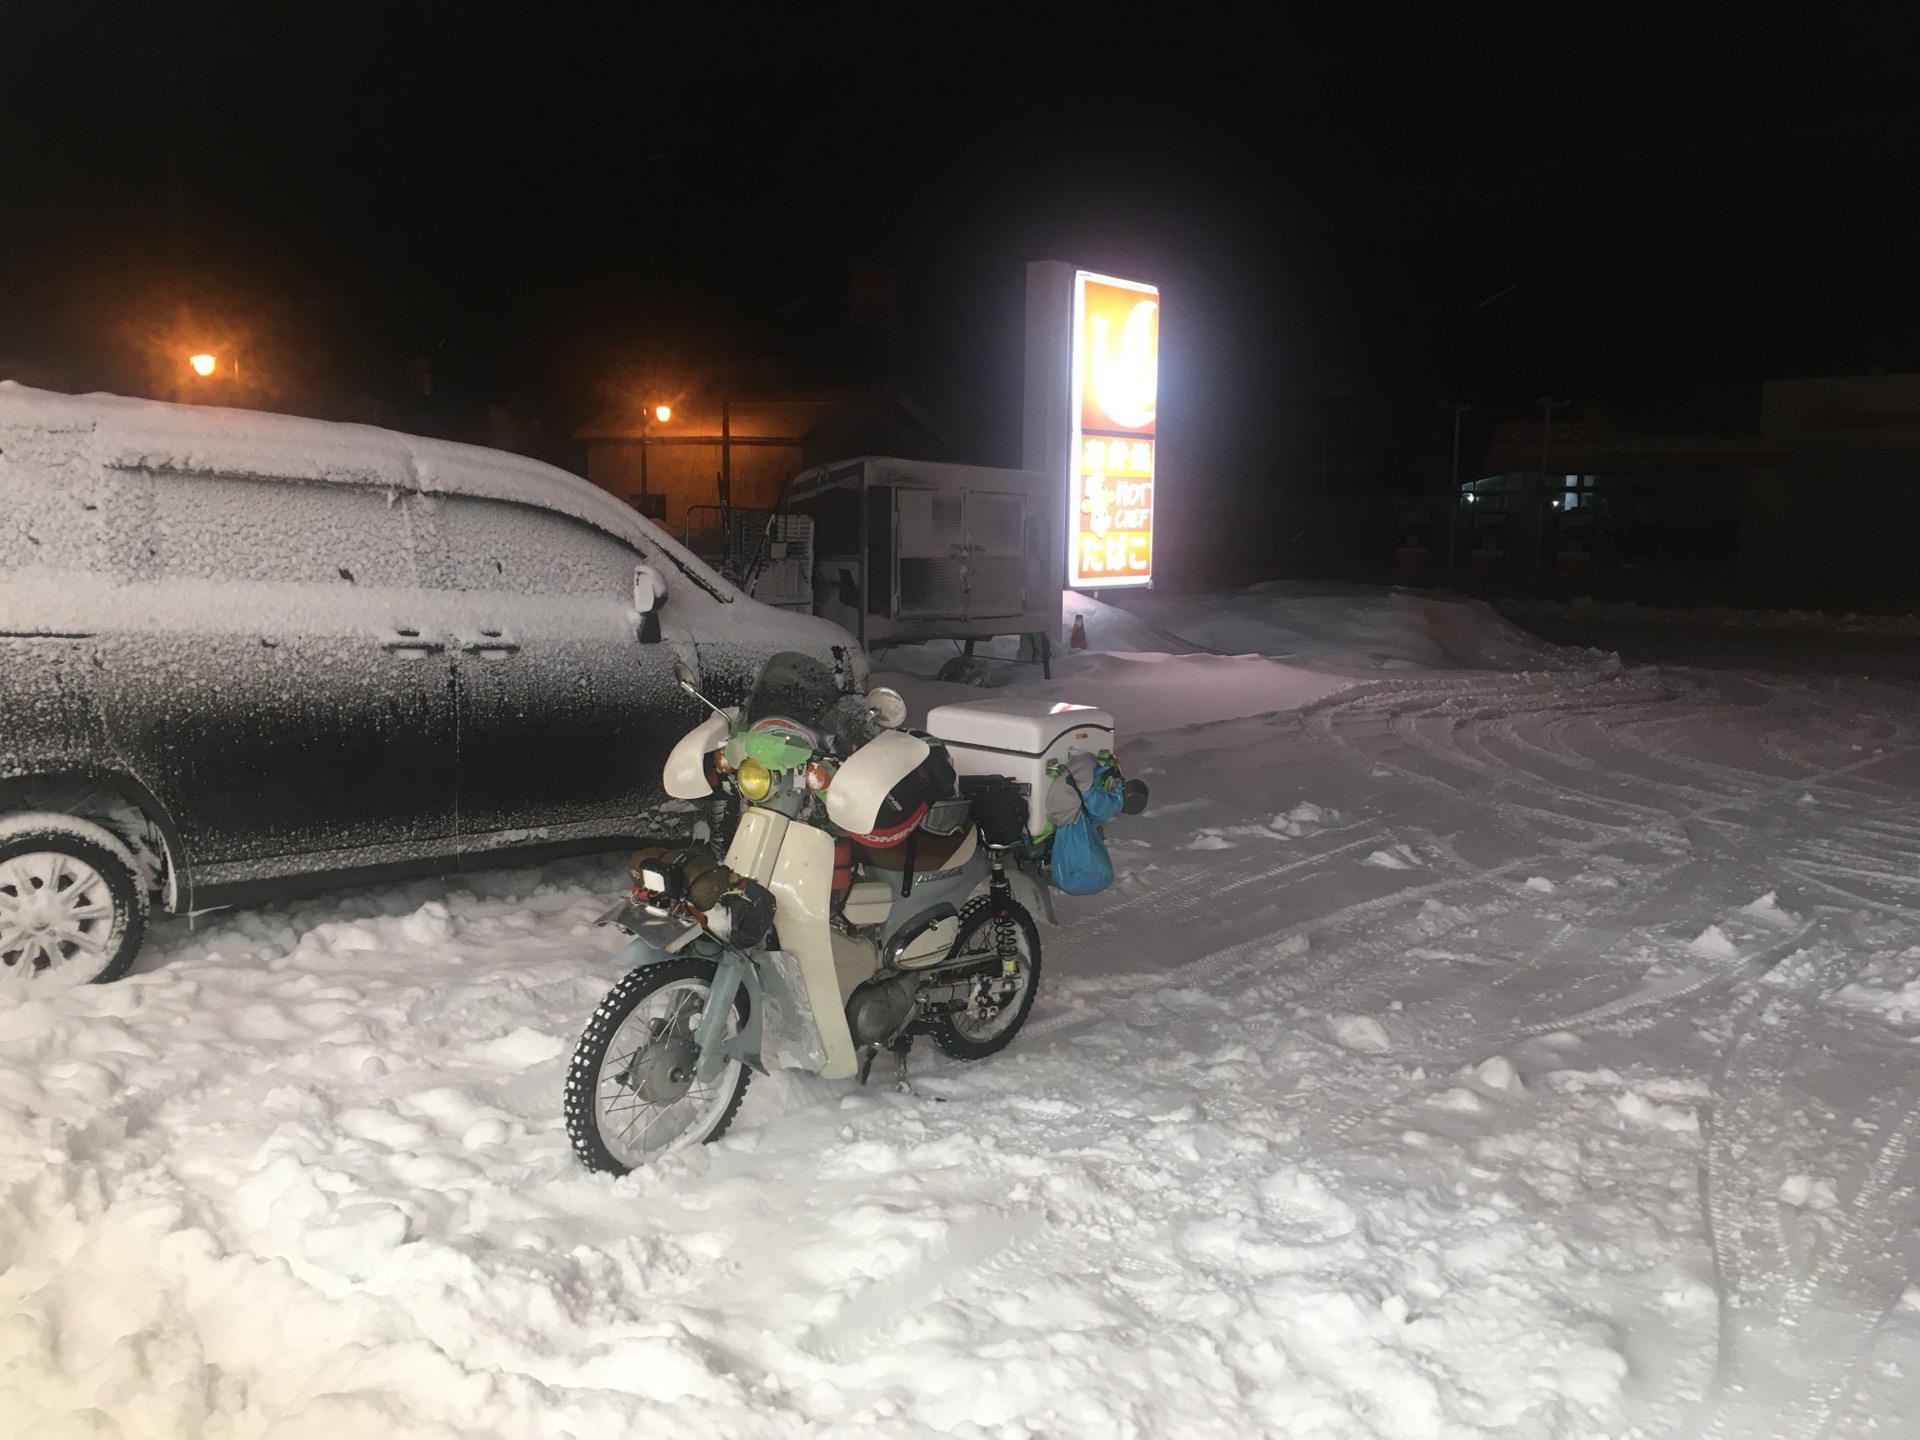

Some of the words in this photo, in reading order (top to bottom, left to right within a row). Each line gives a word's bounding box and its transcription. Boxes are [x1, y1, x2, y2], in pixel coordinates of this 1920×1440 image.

[1115, 479, 1152, 507] HOT
[1114, 508, 1150, 529] CHEF
[1082, 533, 1147, 572] たばこ
[859, 814, 922, 843] OMIN
